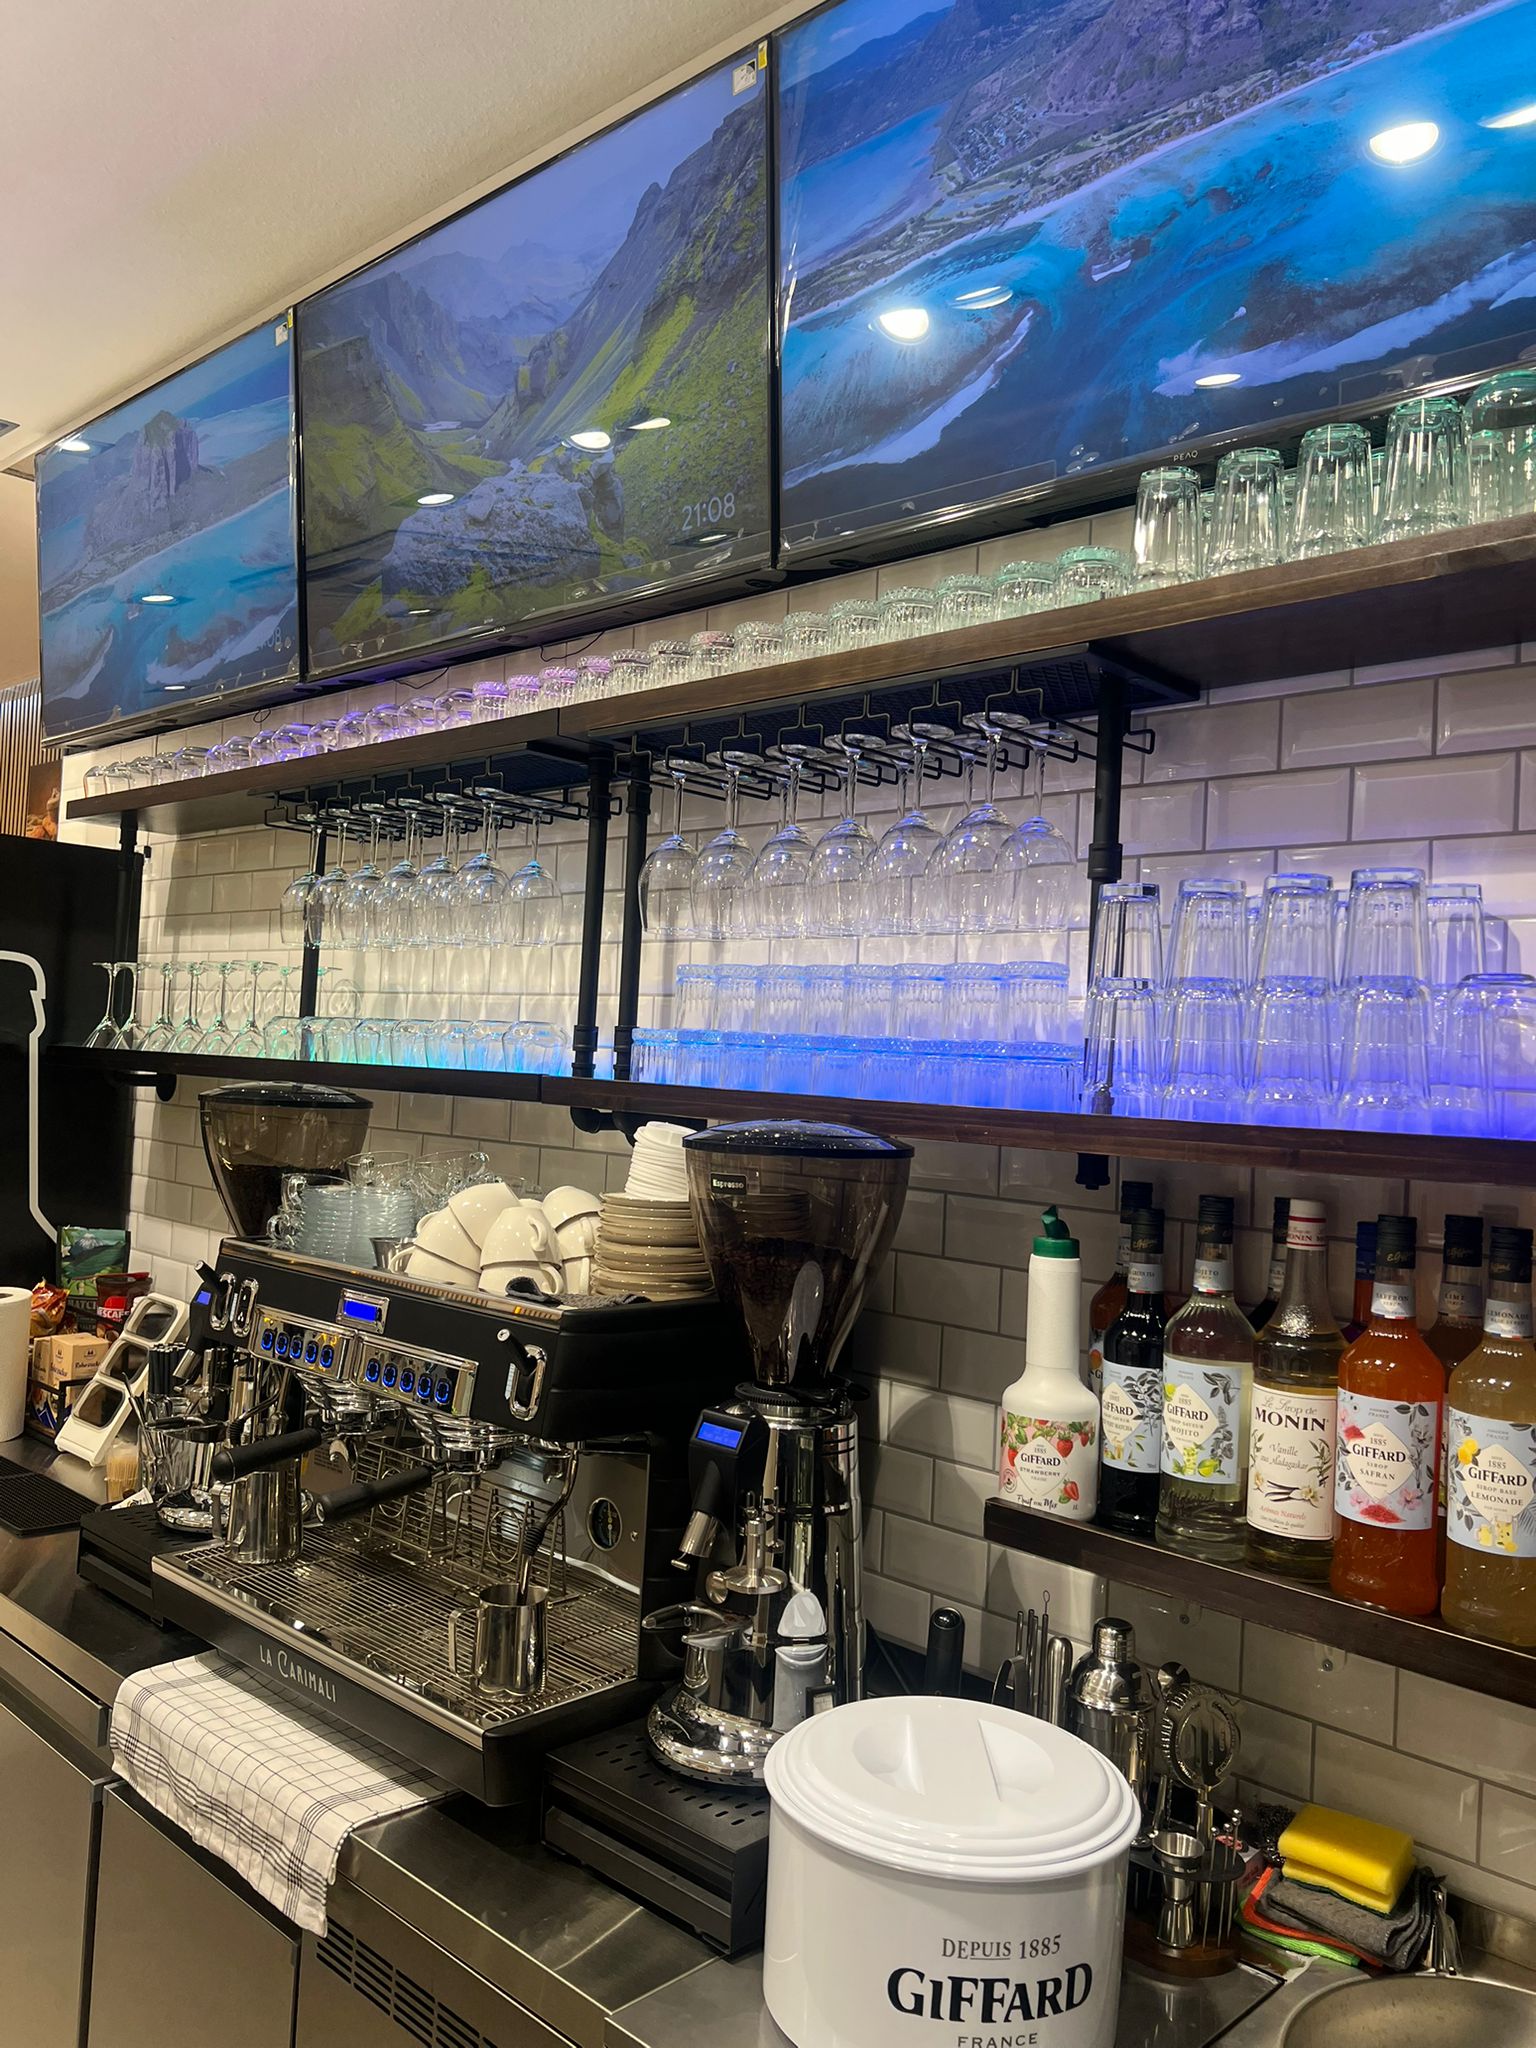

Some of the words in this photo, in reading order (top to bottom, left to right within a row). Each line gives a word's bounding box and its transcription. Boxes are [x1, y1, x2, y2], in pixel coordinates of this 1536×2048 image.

[1173, 450, 1198, 462] PEAQ
[681, 492, 735, 531] 21:08
[712, 1178, 744, 1189] Espresso
[1167, 1403, 1209, 1422] GIFFARD
[1261, 1394, 1275, 1408] Le
[1274, 1397, 1303, 1417] Sirop
[1305, 1407, 1318, 1415] de
[1254, 1406, 1326, 1432] MONIN
[1171, 1425, 1200, 1438] MOJITO
[1370, 1436, 1387, 1446] 1885
[1269, 1442, 1299, 1457] Vanille
[1352, 1443, 1406, 1463] GIFFARD
[1020, 1453, 1061, 1466] GIFFARD
[1367, 1461, 1388, 1470] SIROP
[1488, 1460, 1507, 1470] 1885
[1020, 1467, 1060, 1476] STRAWBERRY
[1360, 1467, 1395, 1481] SAFRAN
[1468, 1466, 1528, 1487] GIFFARD
[1476, 1483, 1497, 1493] SIROP
[1499, 1488, 1518, 1496] BASE
[1471, 1490, 1524, 1507] LEMONADE
[259, 1645, 272, 1667] LA
[277, 1650, 336, 1703] CARIMALI
[942, 1937, 1012, 1960] DEPUIS
[1018, 1934, 1062, 1959] 1885
[887, 1962, 1093, 2024] GIFFARD
[957, 2032, 1038, 2048] FRANCE
